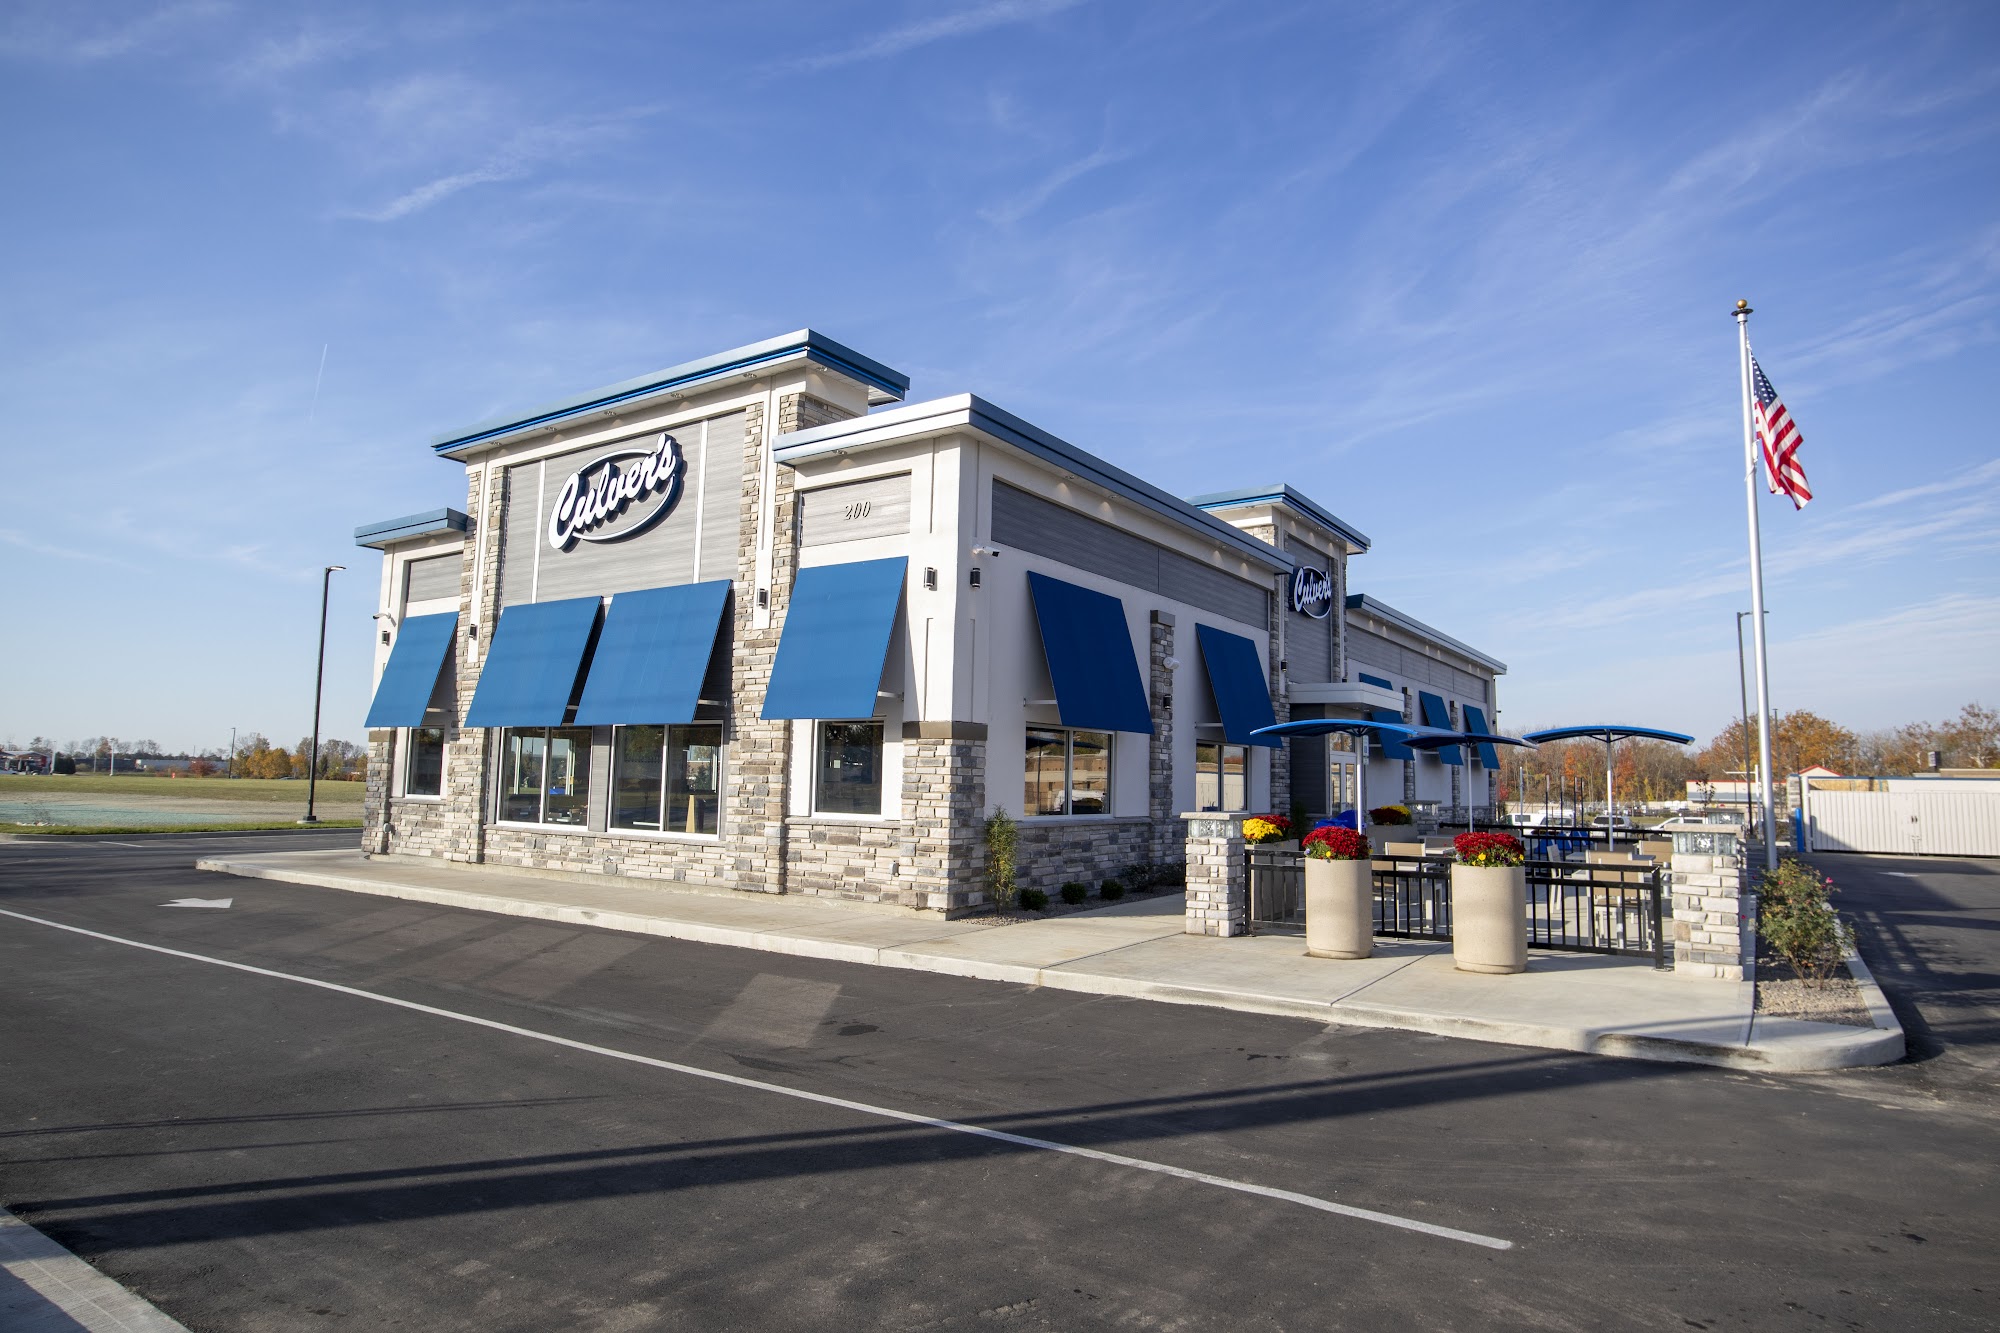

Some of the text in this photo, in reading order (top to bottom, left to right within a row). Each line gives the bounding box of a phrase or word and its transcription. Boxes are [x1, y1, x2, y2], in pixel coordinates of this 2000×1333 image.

[549, 433, 676, 549] Culver's
[844, 501, 871, 521] 200
[1294, 567, 1331, 612] Culver's
